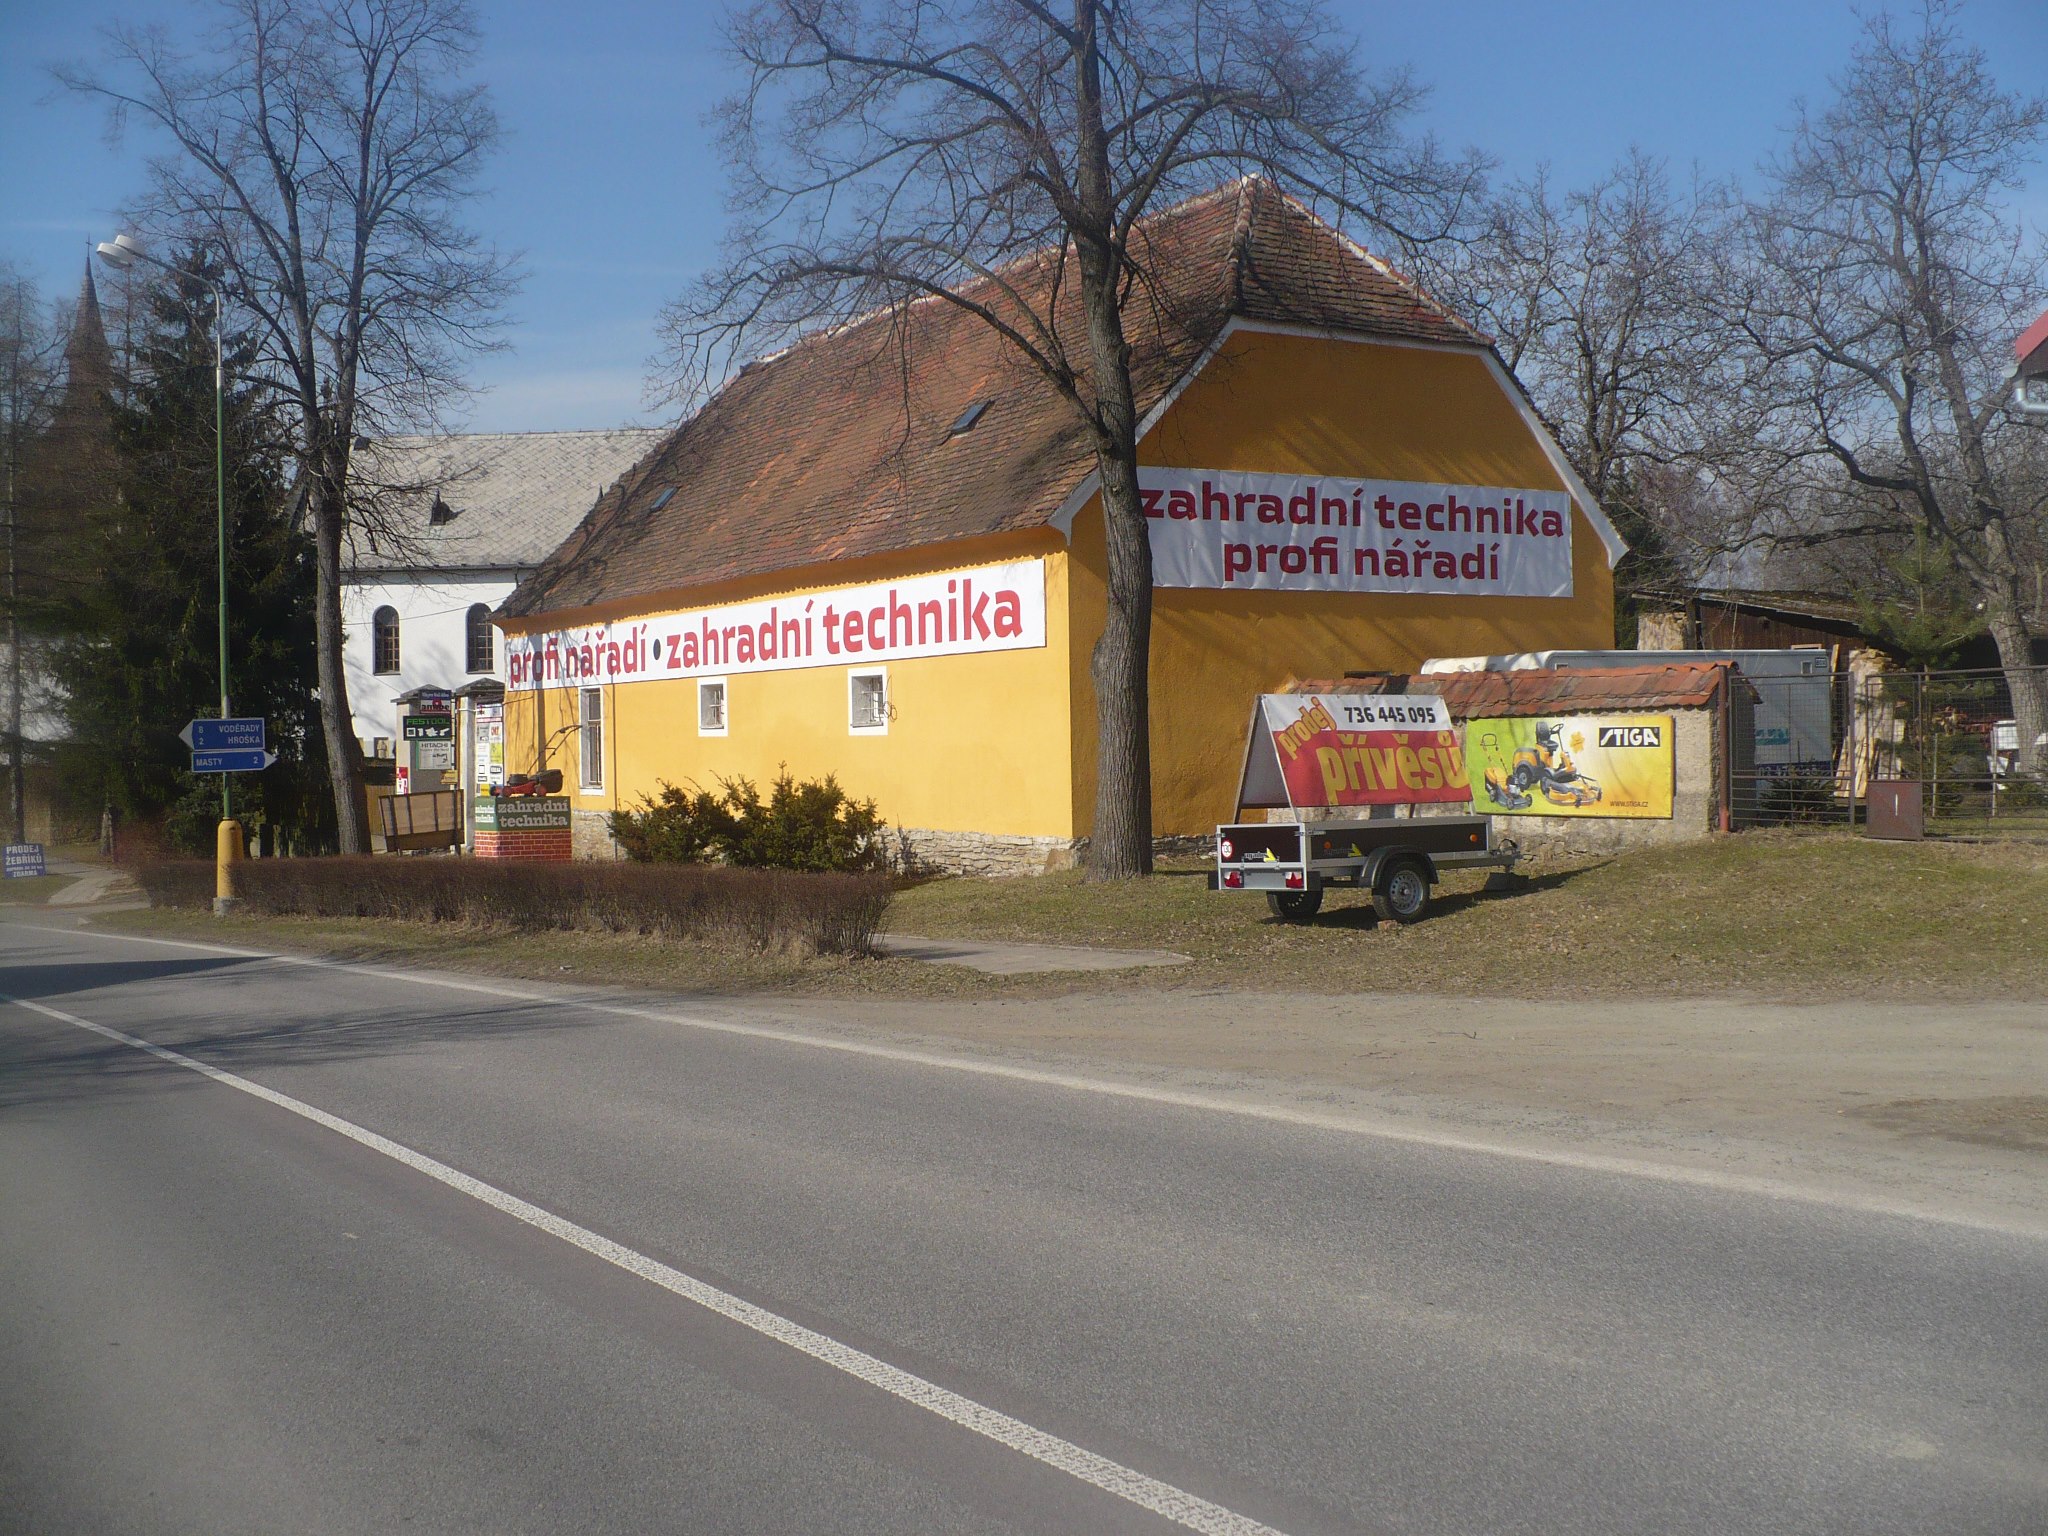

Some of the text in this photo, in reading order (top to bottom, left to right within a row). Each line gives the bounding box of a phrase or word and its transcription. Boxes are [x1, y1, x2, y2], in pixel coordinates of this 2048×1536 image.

[1139, 481, 1563, 537] zahradní technika
[1224, 536, 1500, 581] profi nářadí
[510, 579, 1023, 688] profi nářadí zahradní technika
[1344, 707, 1436, 723] 736 445 095
[219, 724, 260, 733] VODĚRADY
[1278, 696, 1337, 760] prodej
[228, 735, 260, 744] HROŠKA
[1600, 728, 1658, 746] STIGA
[196, 758, 223, 766] MASTY
[1316, 730, 1469, 805] přívěsů
[498, 800, 568, 813] zahradní
[499, 814, 568, 827] technika
[6, 845, 39, 854] PRODEJ
[6, 853, 42, 865] ŽEBŘÍKŮ
